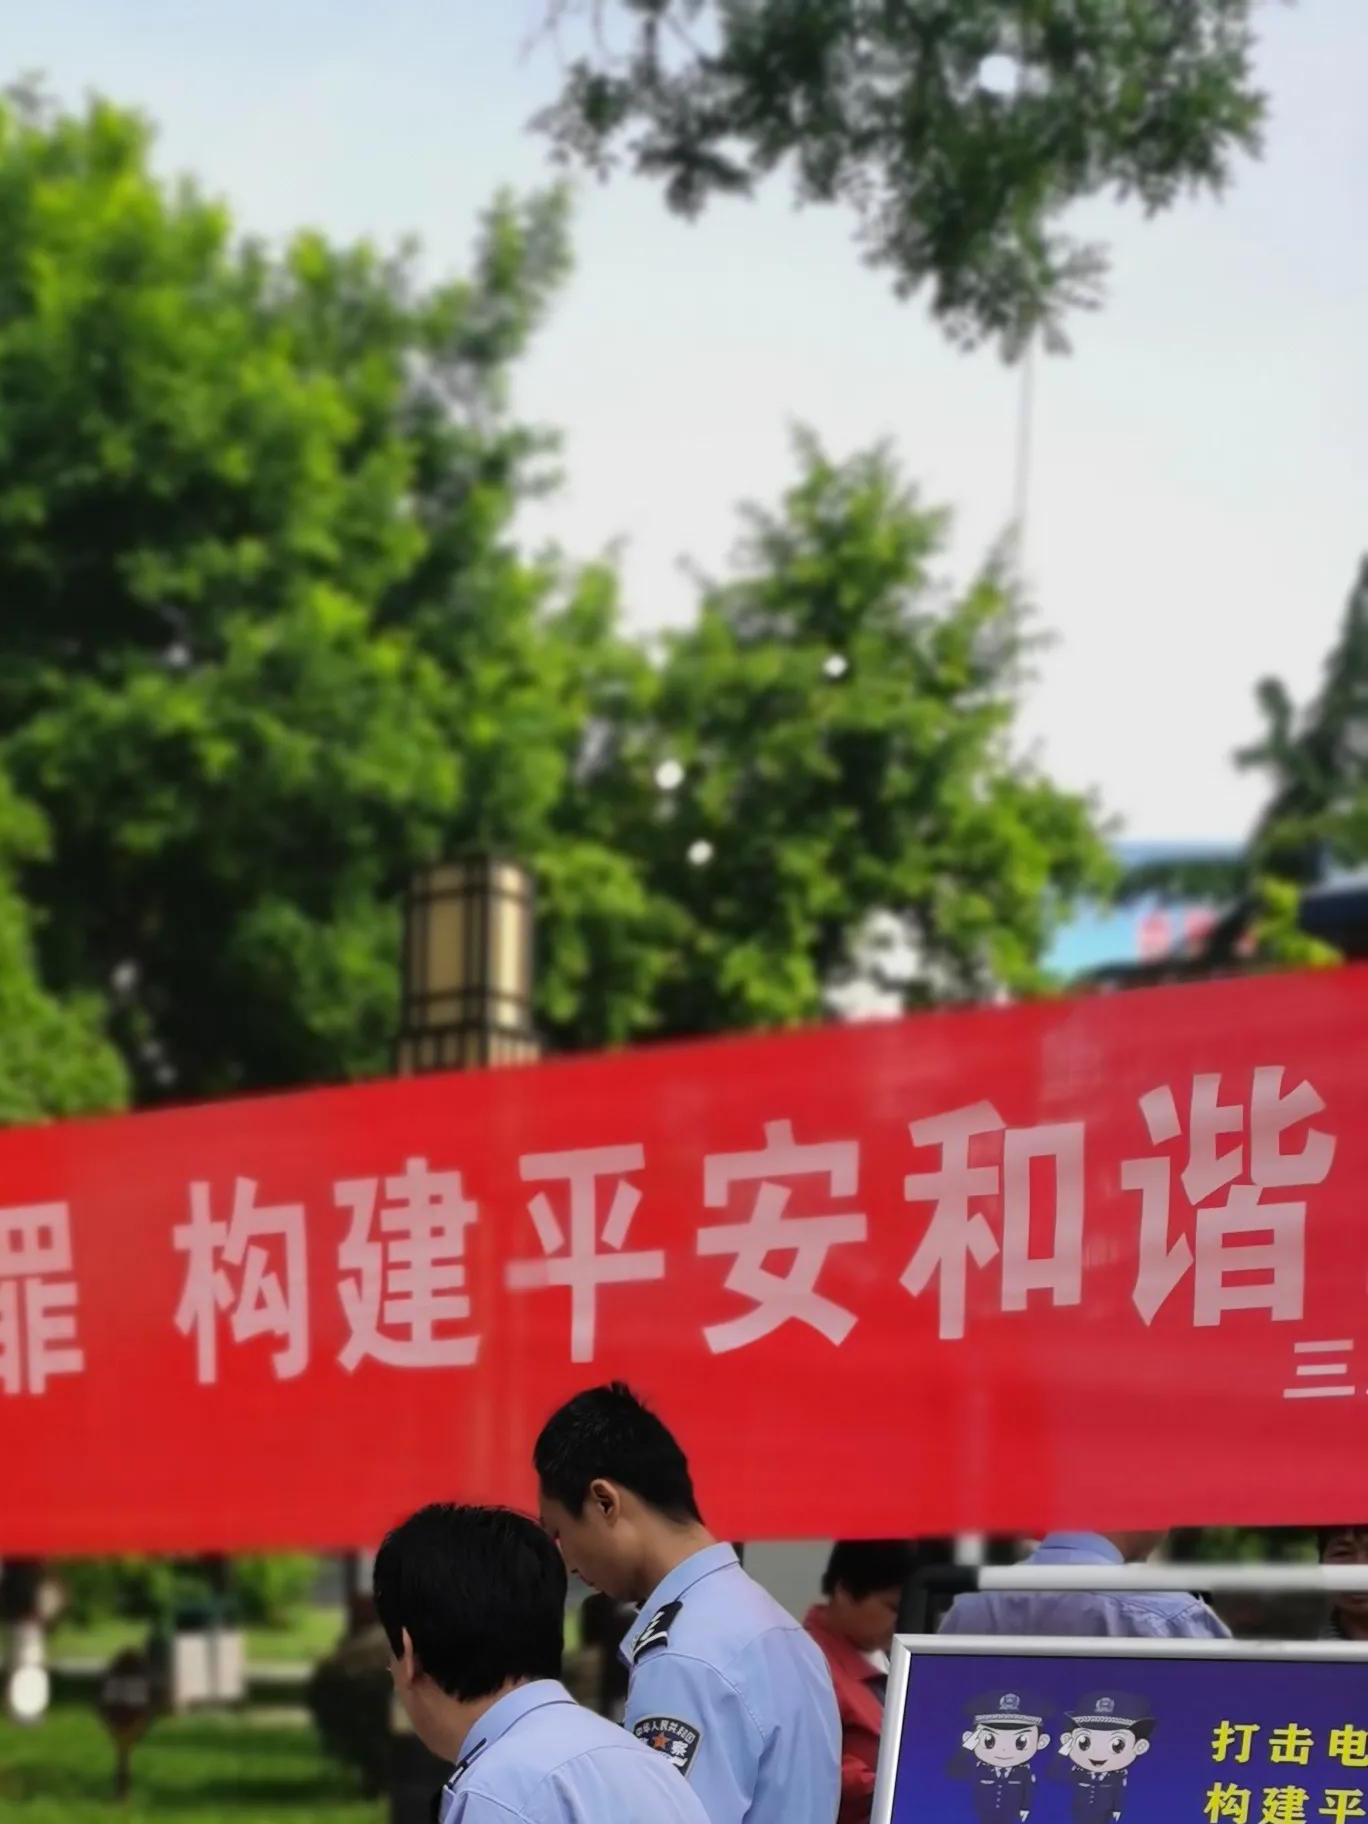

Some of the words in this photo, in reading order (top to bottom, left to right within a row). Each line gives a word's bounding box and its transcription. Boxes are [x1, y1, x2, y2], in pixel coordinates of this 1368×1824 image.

[173, 1065, 1337, 1384] 构建平安和谐
[1283, 1339, 1356, 1398] 三
[635, 1719, 696, 1744] 中华人民共和国
[1211, 1720, 1368, 1767] 打击电
